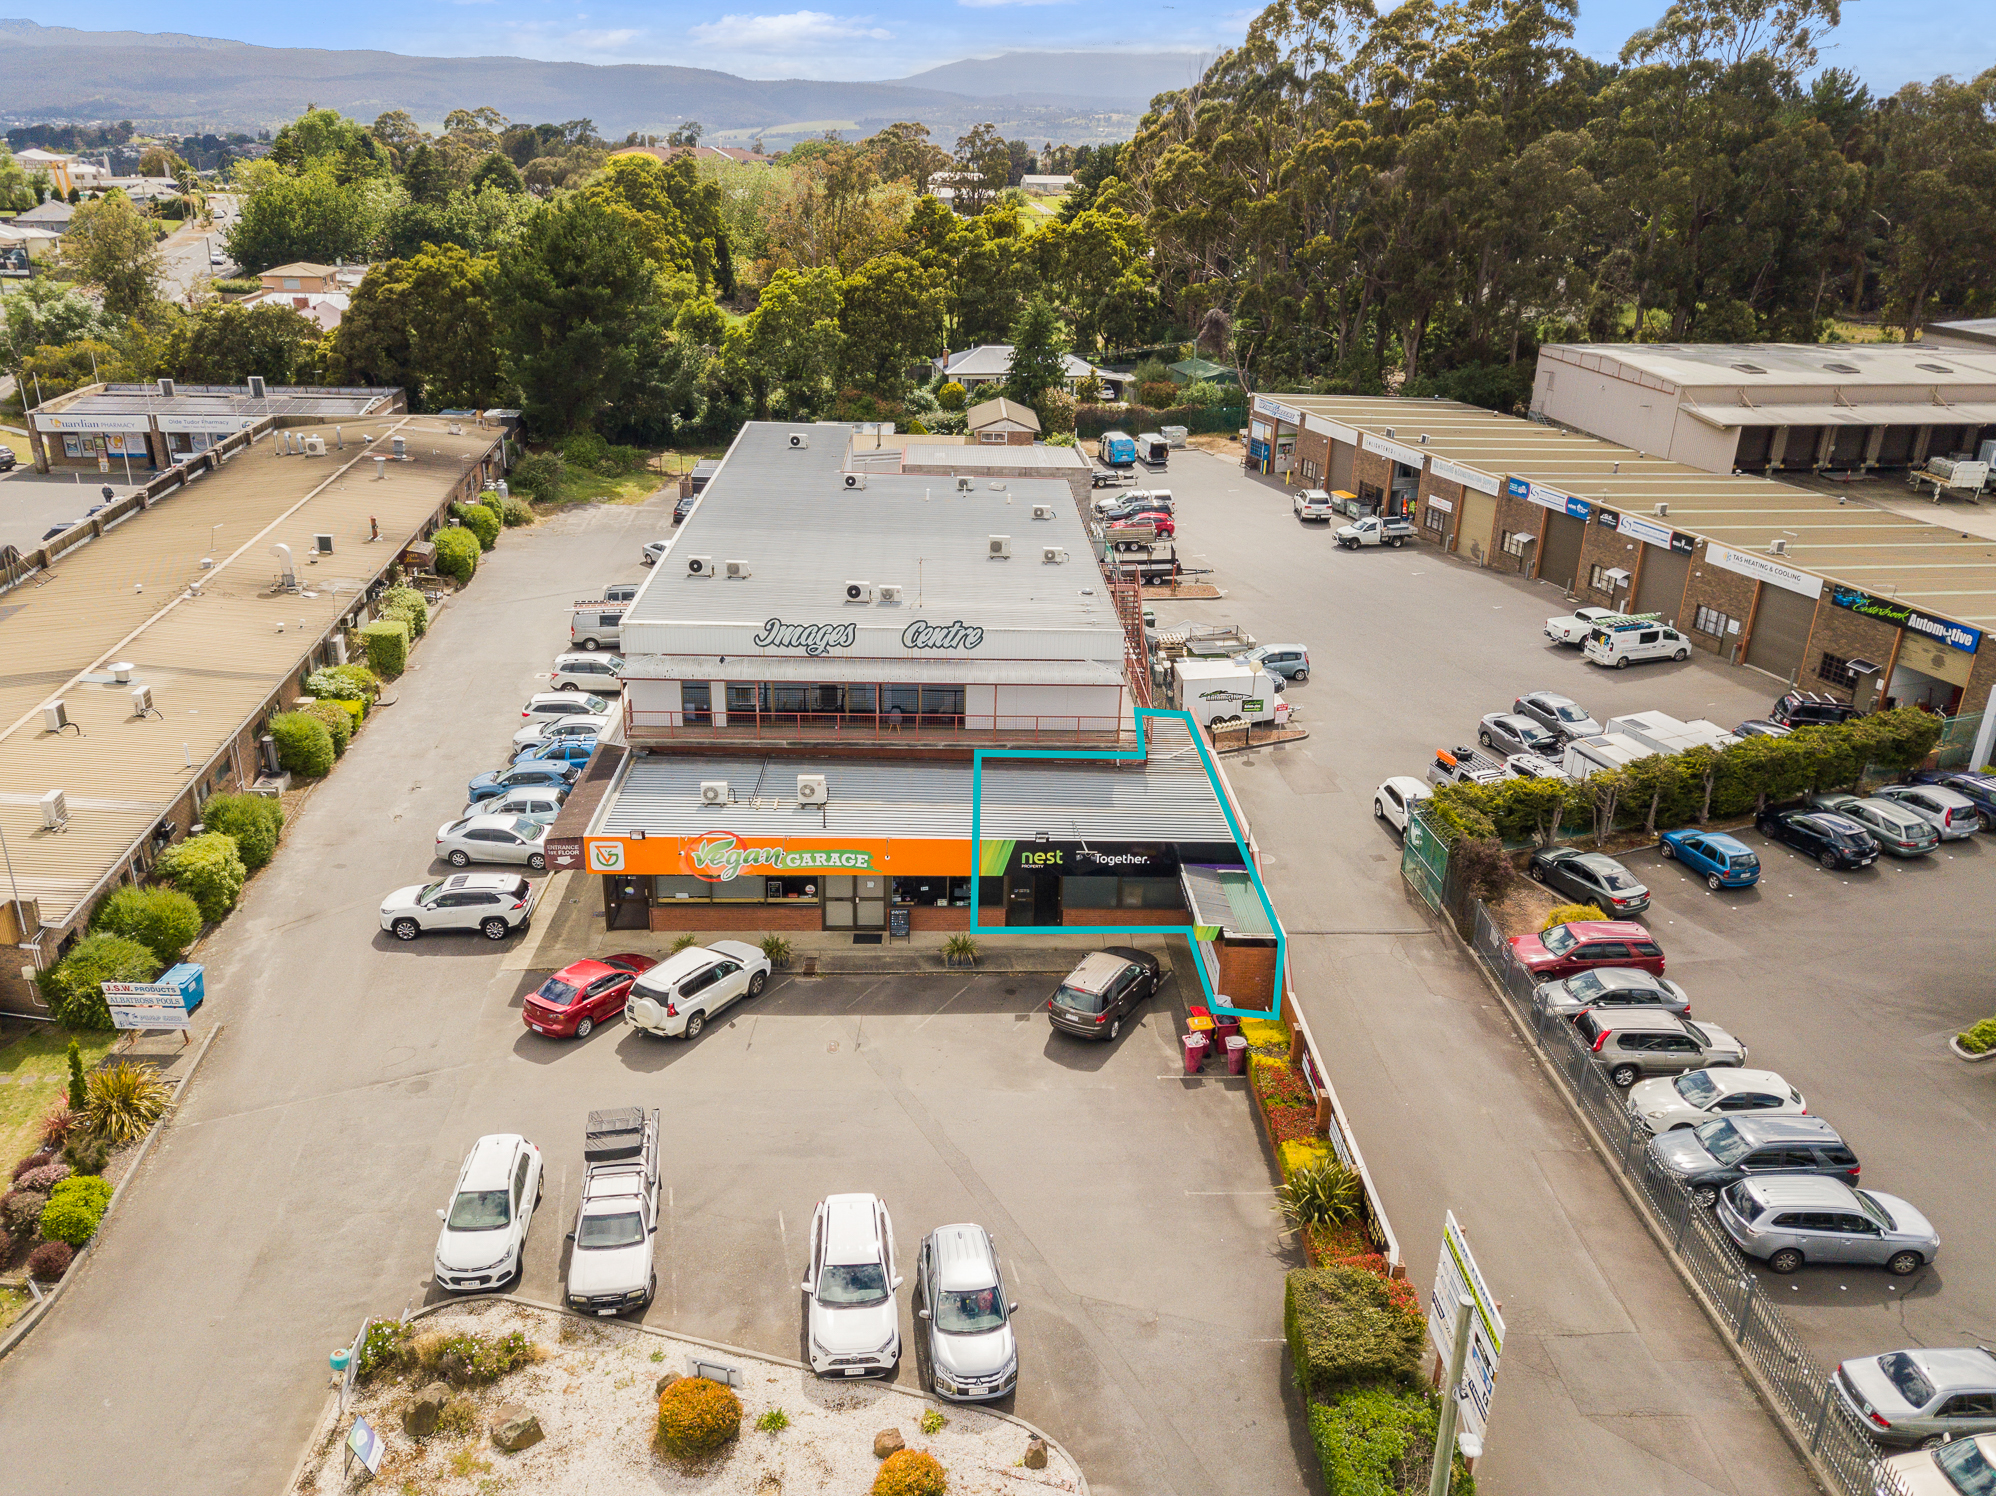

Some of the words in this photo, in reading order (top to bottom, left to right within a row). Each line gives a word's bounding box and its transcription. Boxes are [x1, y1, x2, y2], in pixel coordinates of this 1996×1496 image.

[1733, 554, 1743, 563] TAS
[1744, 557, 1768, 571] HEATING
[1774, 568, 1801, 582] COOLING
[1852, 598, 1912, 622] Easterbrook
[754, 617, 857, 656] Images
[902, 619, 984, 650] Centre
[691, 837, 783, 881] Vegan
[786, 853, 868, 868] GARAGE
[1021, 850, 1063, 864] nest
[1095, 853, 1150, 866] Together.
[1364, 1189, 1374, 1220] THIS
[1375, 1216, 1385, 1246] WAY
[1368, 1219, 1378, 1246] OUT
